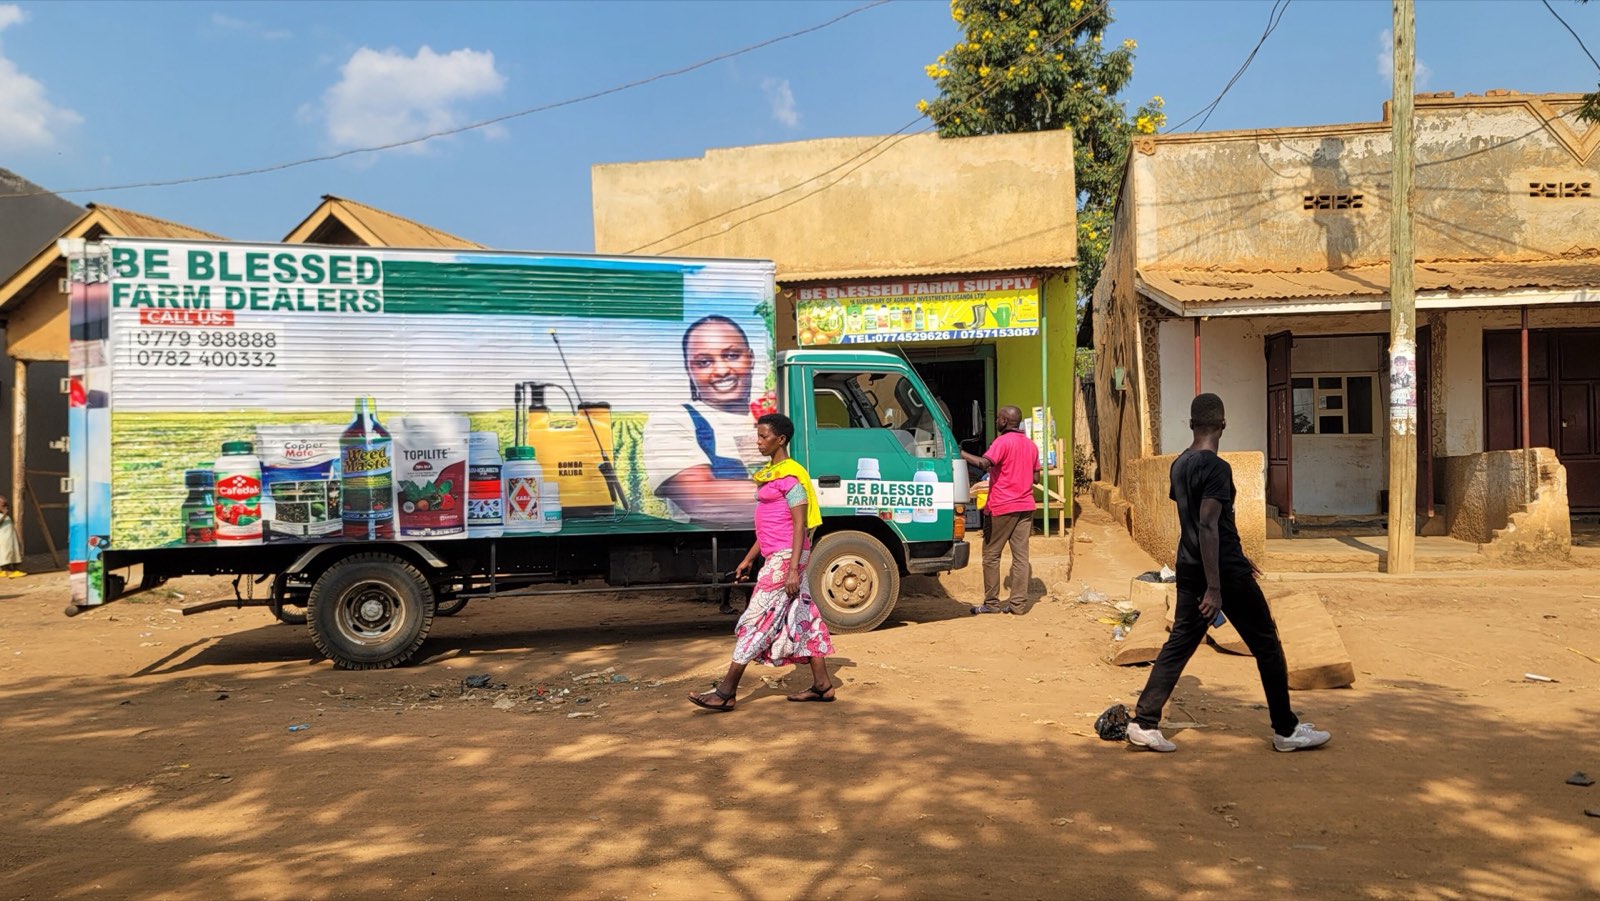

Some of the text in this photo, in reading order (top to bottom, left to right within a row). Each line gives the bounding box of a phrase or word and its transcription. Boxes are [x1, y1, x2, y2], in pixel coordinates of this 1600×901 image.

[112, 247, 382, 285] BE BLESSED
[801, 277, 1034, 300] BE BLESSED FARM SUPPLY
[112, 283, 382, 313] FARM DEALERS
[917, 294, 952, 302] INVESTMENTS
[147, 310, 227, 325] CALL US:
[137, 330, 277, 348] 0779 988888
[960, 327, 1038, 340] 0757153087
[137, 350, 277, 368] 0782 400332
[284, 441, 323, 451] Copper
[346, 446, 386, 461] Weed
[403, 448, 448, 460] TOPILITE
[558, 461, 583, 469] BOMBA
[219, 485, 260, 496] Cafedak
[847, 482, 934, 496] BE BLESSED
[847, 495, 933, 507] FARM DEALERS
